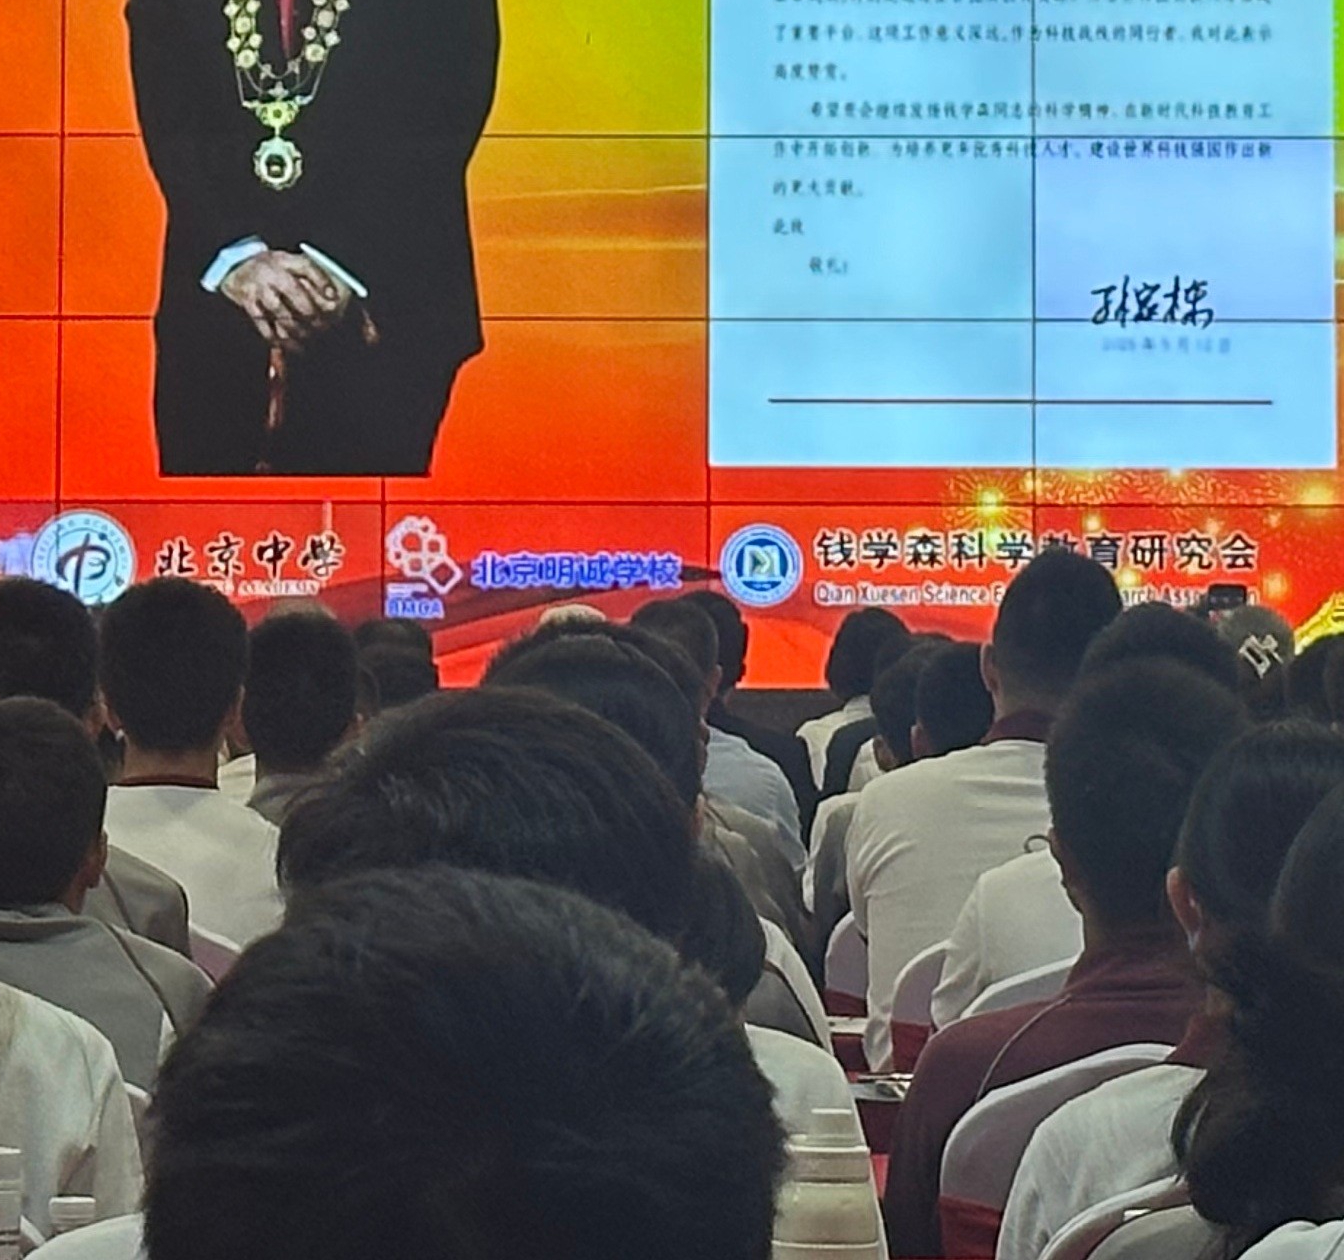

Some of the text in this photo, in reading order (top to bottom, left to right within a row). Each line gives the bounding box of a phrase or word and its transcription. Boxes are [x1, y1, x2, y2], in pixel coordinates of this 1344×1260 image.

[158, 535, 344, 580] 北京中学
[471, 552, 682, 589] 北京明诚学校
[816, 585, 855, 605] Qian
[859, 585, 920, 603] Xuesen
[924, 585, 988, 603] Science
